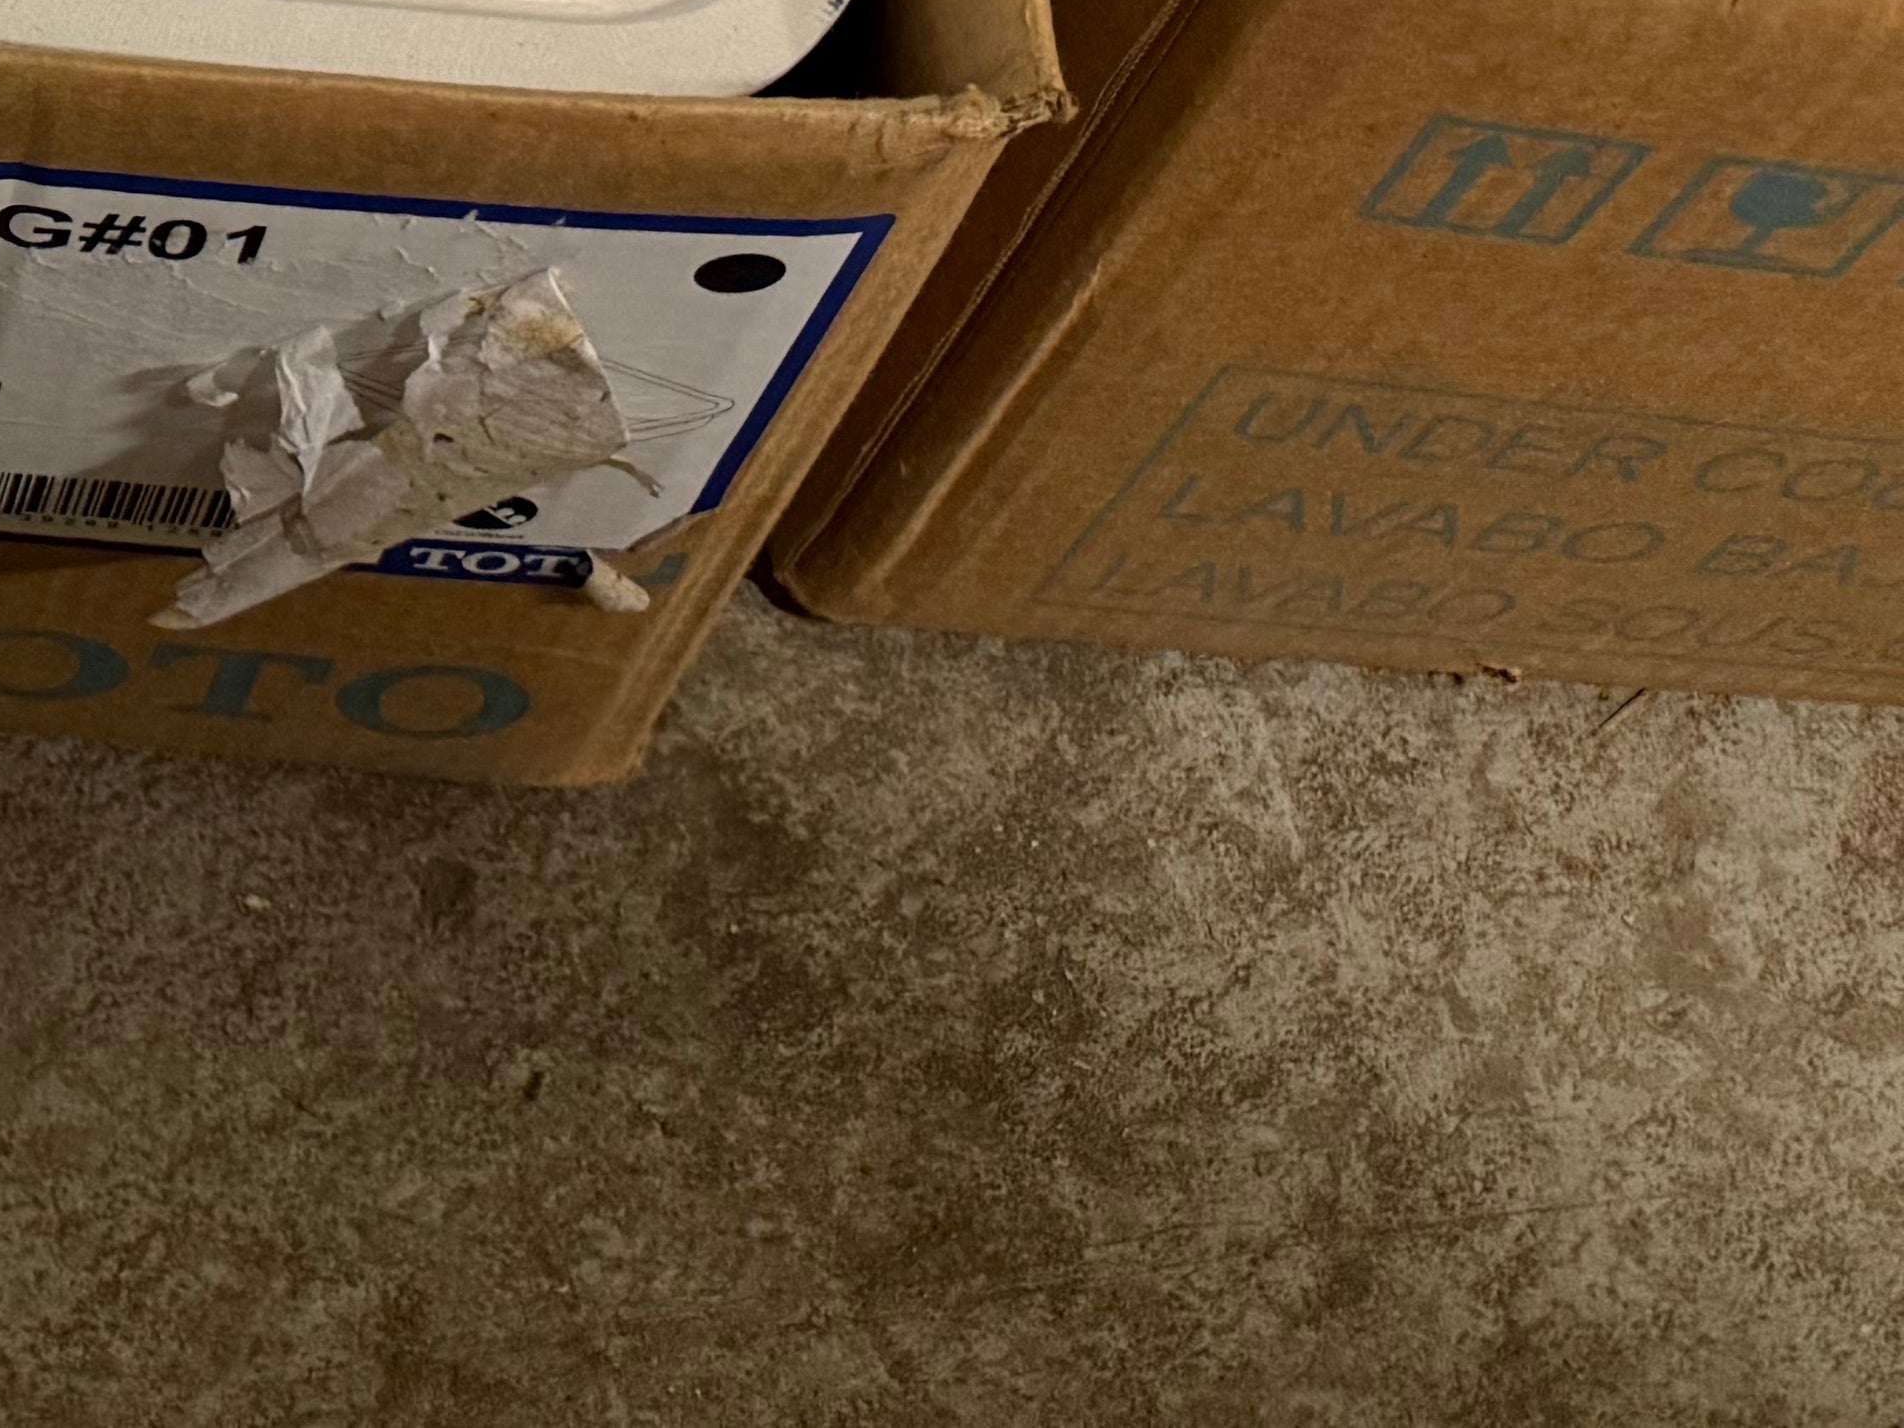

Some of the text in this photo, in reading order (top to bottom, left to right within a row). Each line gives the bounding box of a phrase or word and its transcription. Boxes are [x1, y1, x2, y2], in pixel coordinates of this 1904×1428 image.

[1232, 389, 1670, 485] UNDER
[409, 546, 592, 579] TOT
[1158, 474, 1667, 566] LAVABO
[1092, 552, 1854, 656] LAVABO SOUS
